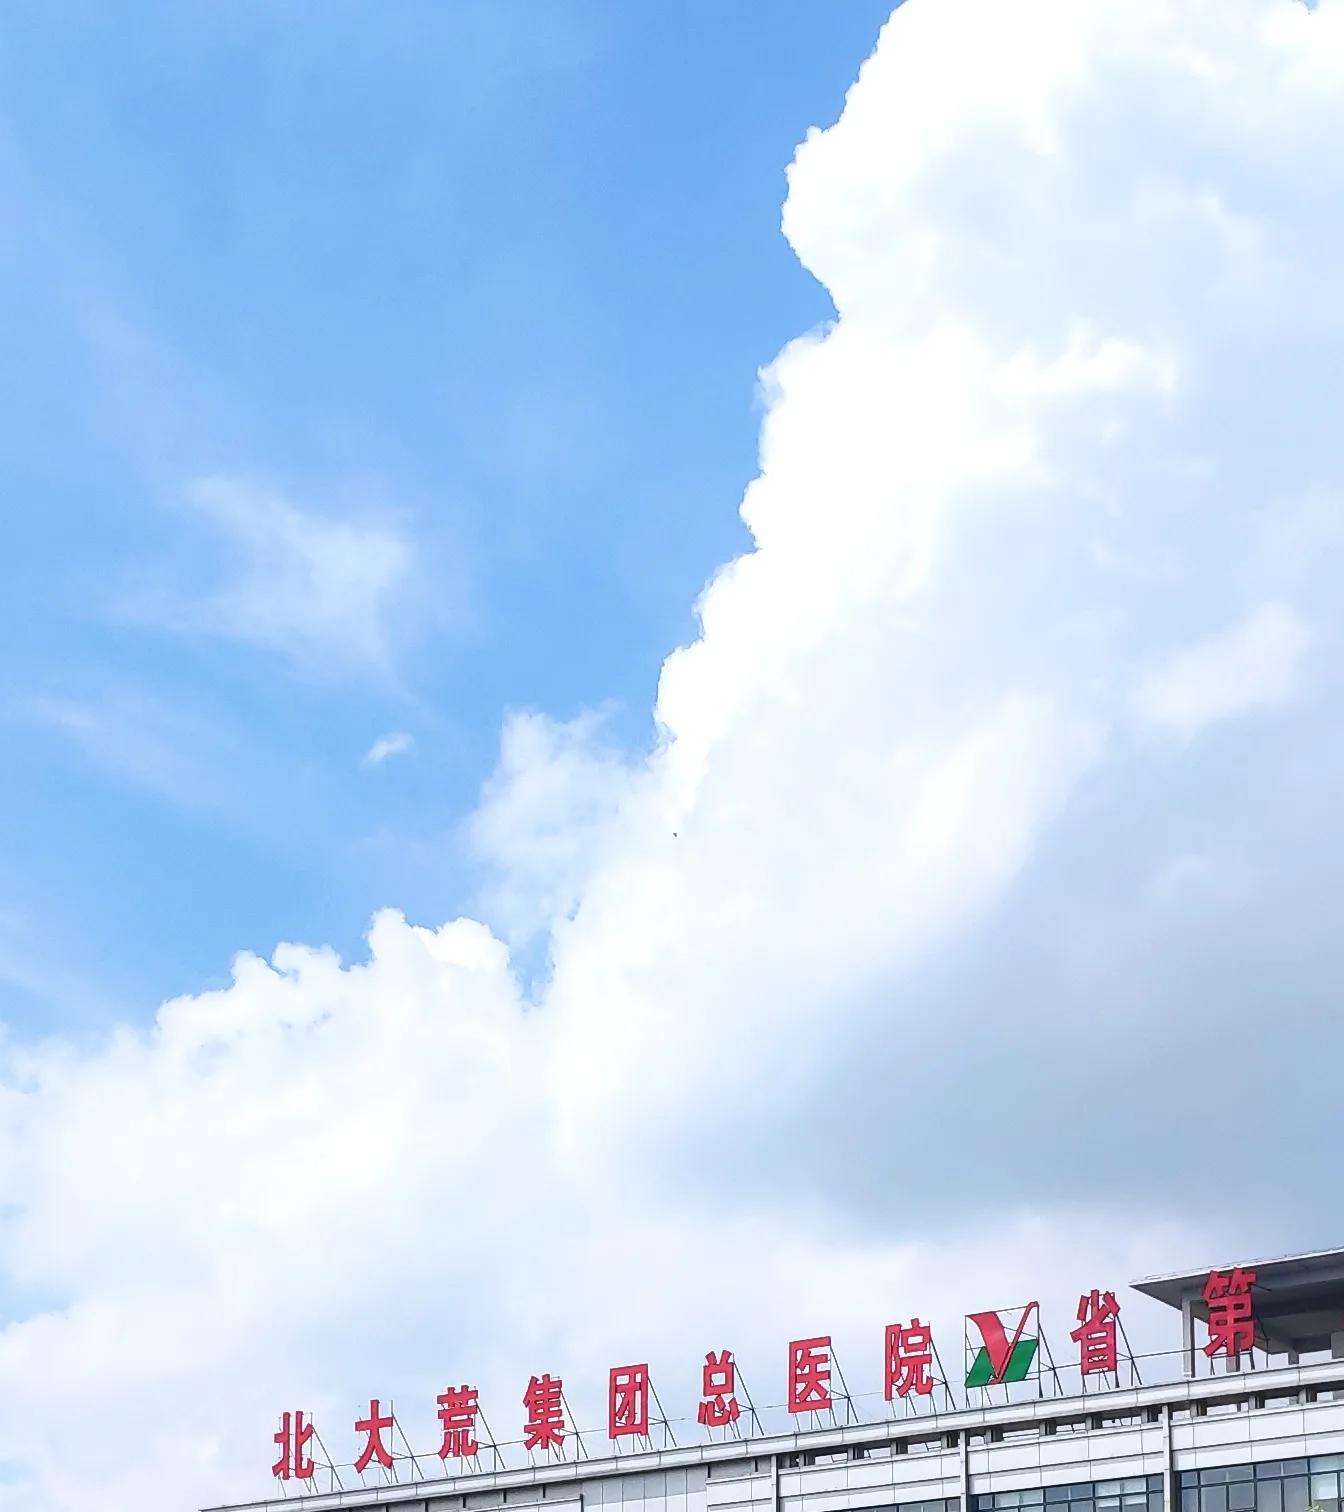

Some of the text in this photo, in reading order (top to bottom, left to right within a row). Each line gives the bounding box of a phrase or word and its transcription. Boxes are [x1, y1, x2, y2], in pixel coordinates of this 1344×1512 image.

[273, 1320, 934, 1480] 北大荒集团总医院
